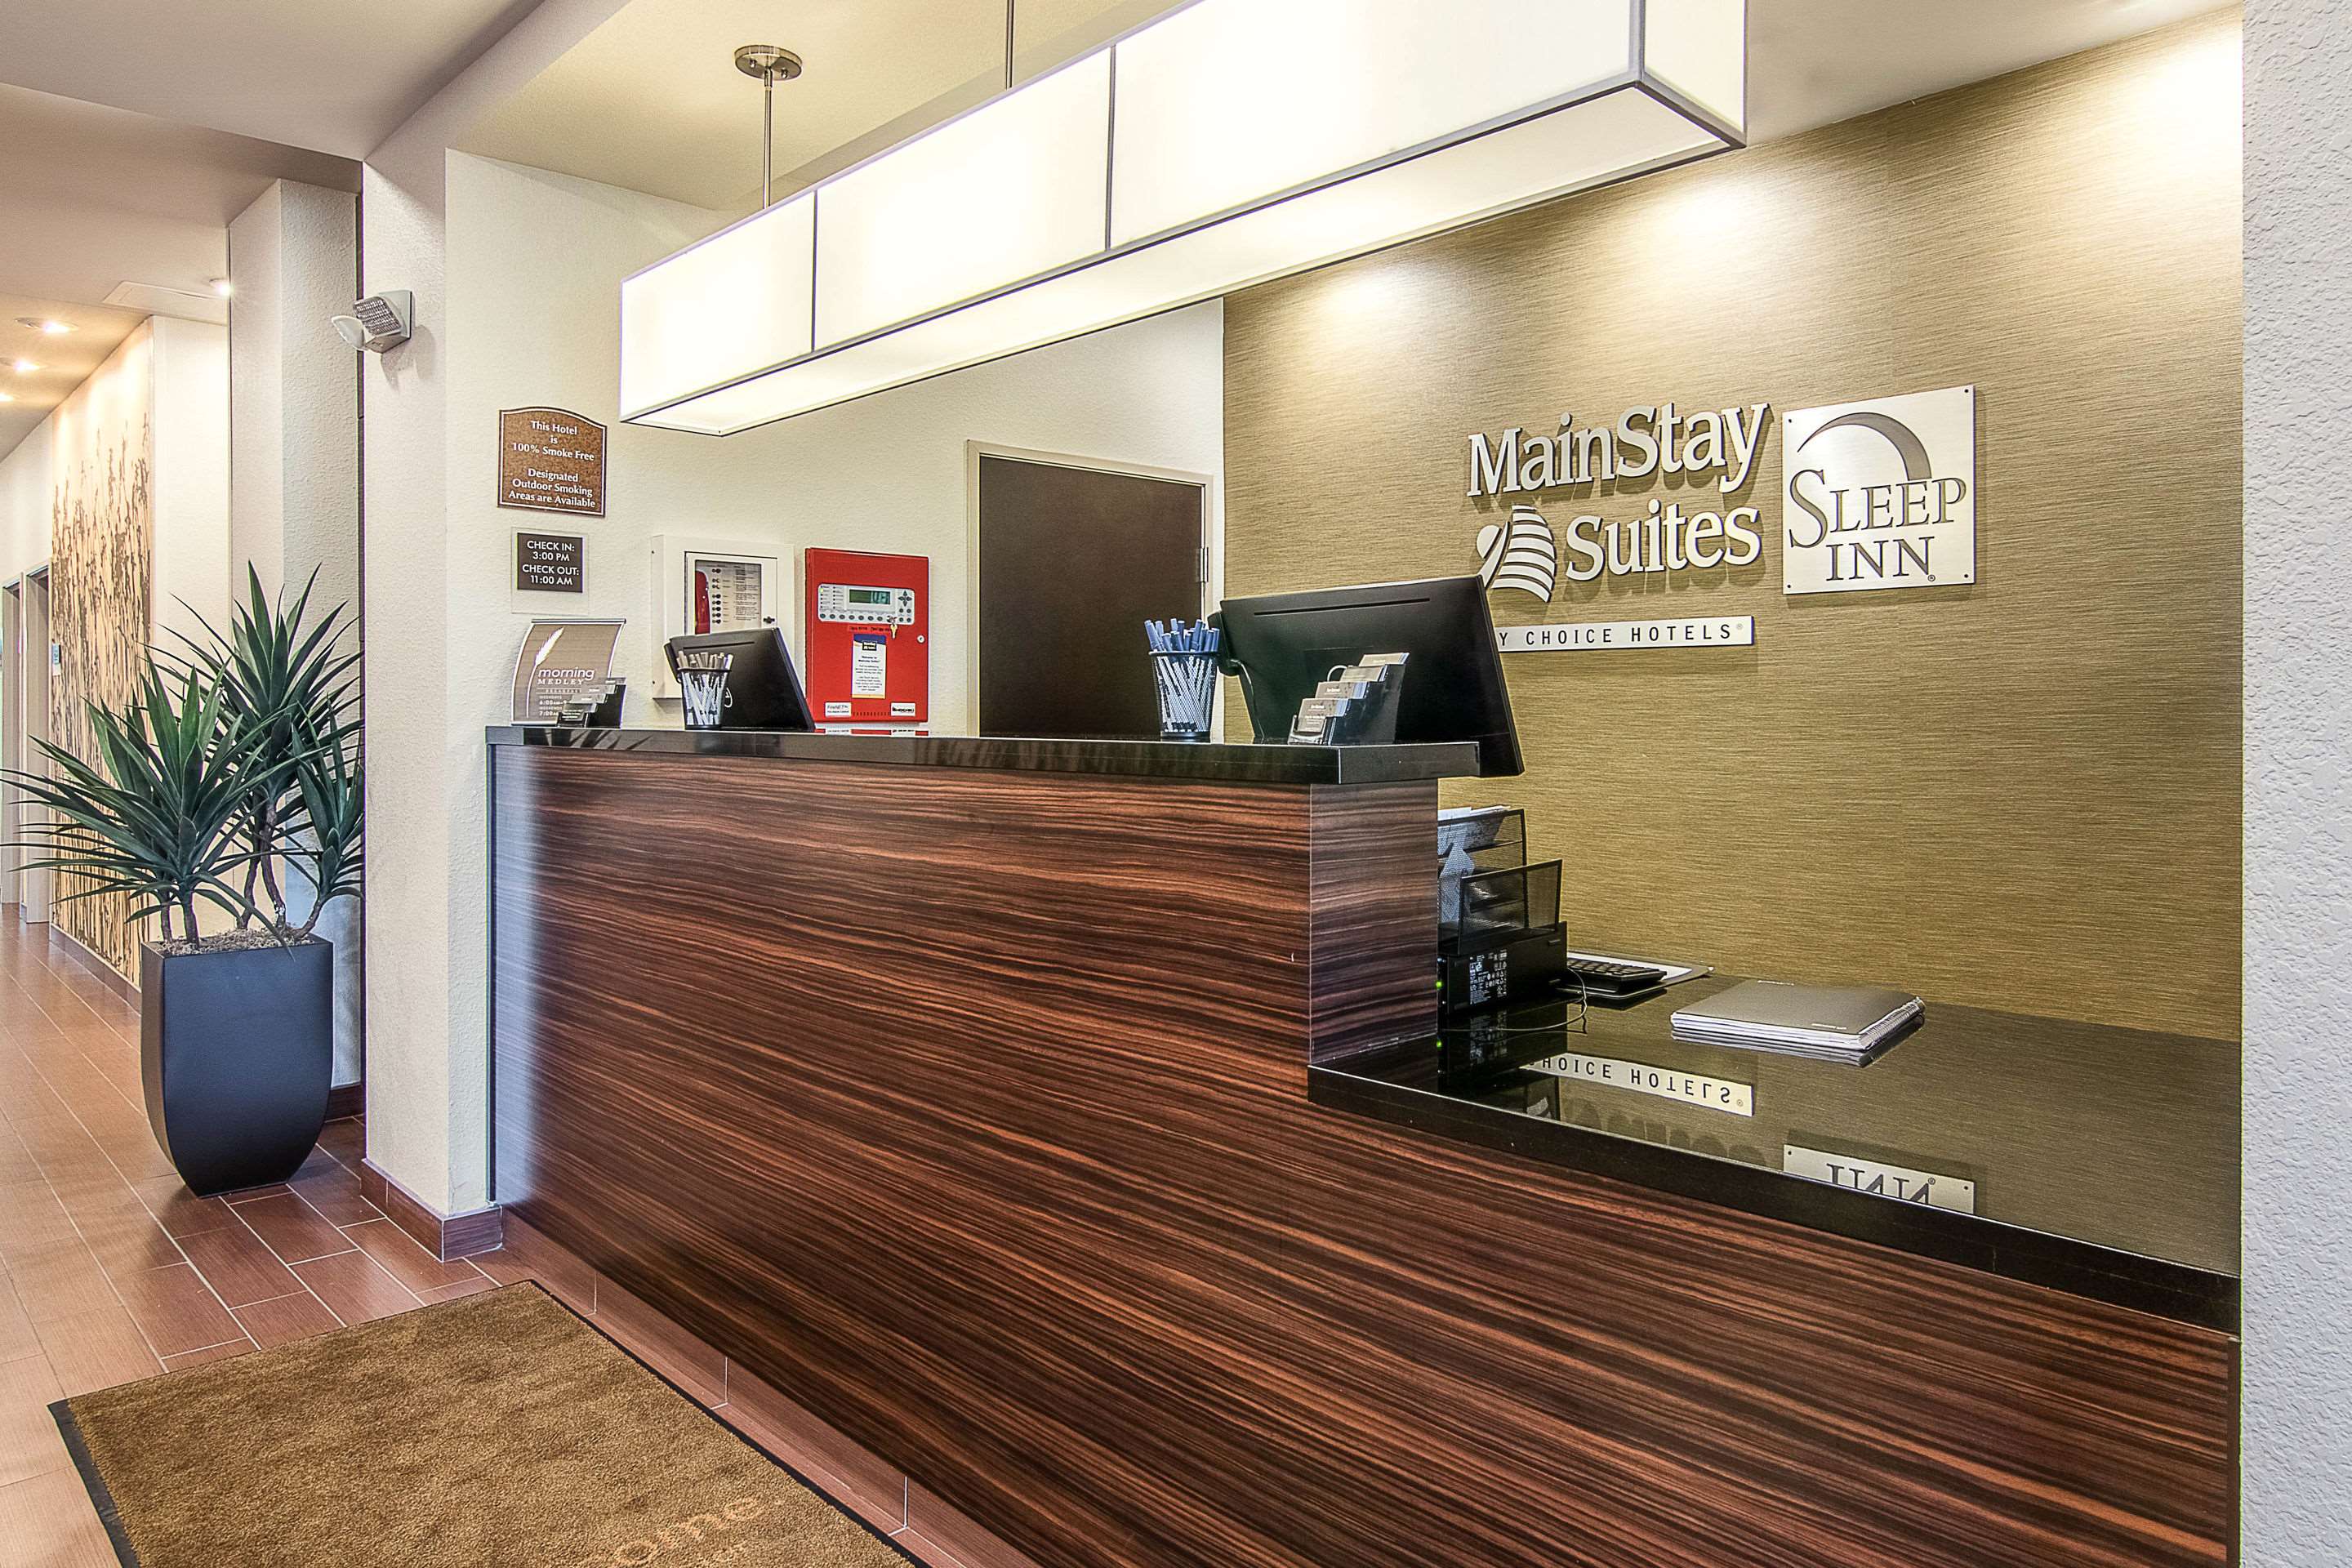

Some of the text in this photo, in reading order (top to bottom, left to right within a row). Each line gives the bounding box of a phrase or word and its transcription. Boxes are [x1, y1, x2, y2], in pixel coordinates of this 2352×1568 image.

[531, 421, 577, 435] This Hotel
[550, 435, 558, 444] is
[513, 443, 595, 461] 100% Smoke Free
[1468, 402, 1771, 497] MainStay
[528, 468, 578, 482] Designated
[512, 479, 593, 497] Outdoor Smoking
[509, 491, 535, 501] Areas
[555, 496, 595, 508] Available
[1789, 469, 1967, 550] SLEEP
[527, 541, 575, 552] CHECK IN:
[1566, 498, 1762, 581] Suites
[532, 551, 570, 562] 3:00 PM
[522, 564, 579, 576] CHECK OUT:
[530, 575, 572, 586] 11:00 AM
[1499, 632, 1508, 646] Y
[1526, 628, 1612, 646] CHOICE
[538, 666, 595, 681] morning
